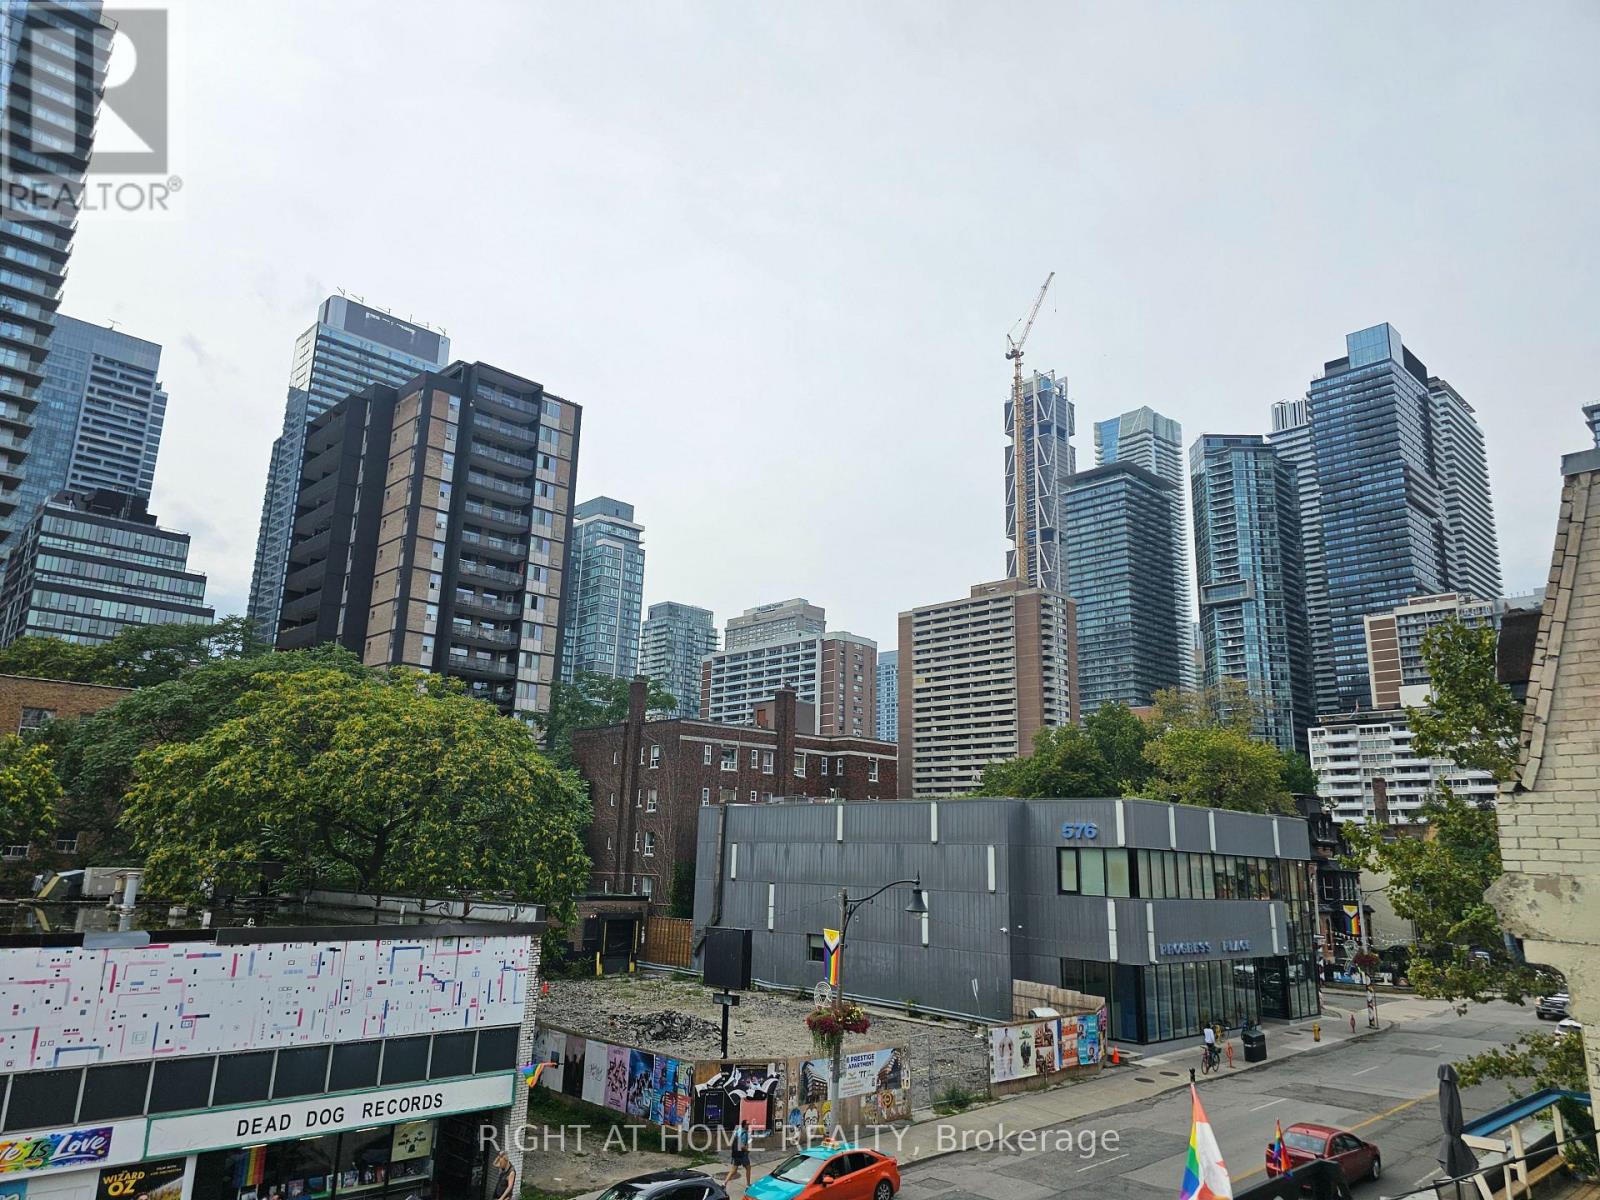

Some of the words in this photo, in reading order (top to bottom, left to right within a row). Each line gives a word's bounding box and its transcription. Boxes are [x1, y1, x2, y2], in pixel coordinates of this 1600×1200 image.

[1060, 822, 1098, 840] 576
[1160, 942, 1211, 956] PROGRESS
[851, 1053, 875, 1062] PRESTIGE
[236, 1113, 292, 1137] DEAD
[306, 1107, 345, 1128] DOG
[362, 1092, 443, 1119] RECORDS
[26, 1140, 51, 1159] Is
[49, 1135, 108, 1161] Love
[103, 1171, 145, 1185] WIZARD
[108, 1180, 137, 1196] OZ
